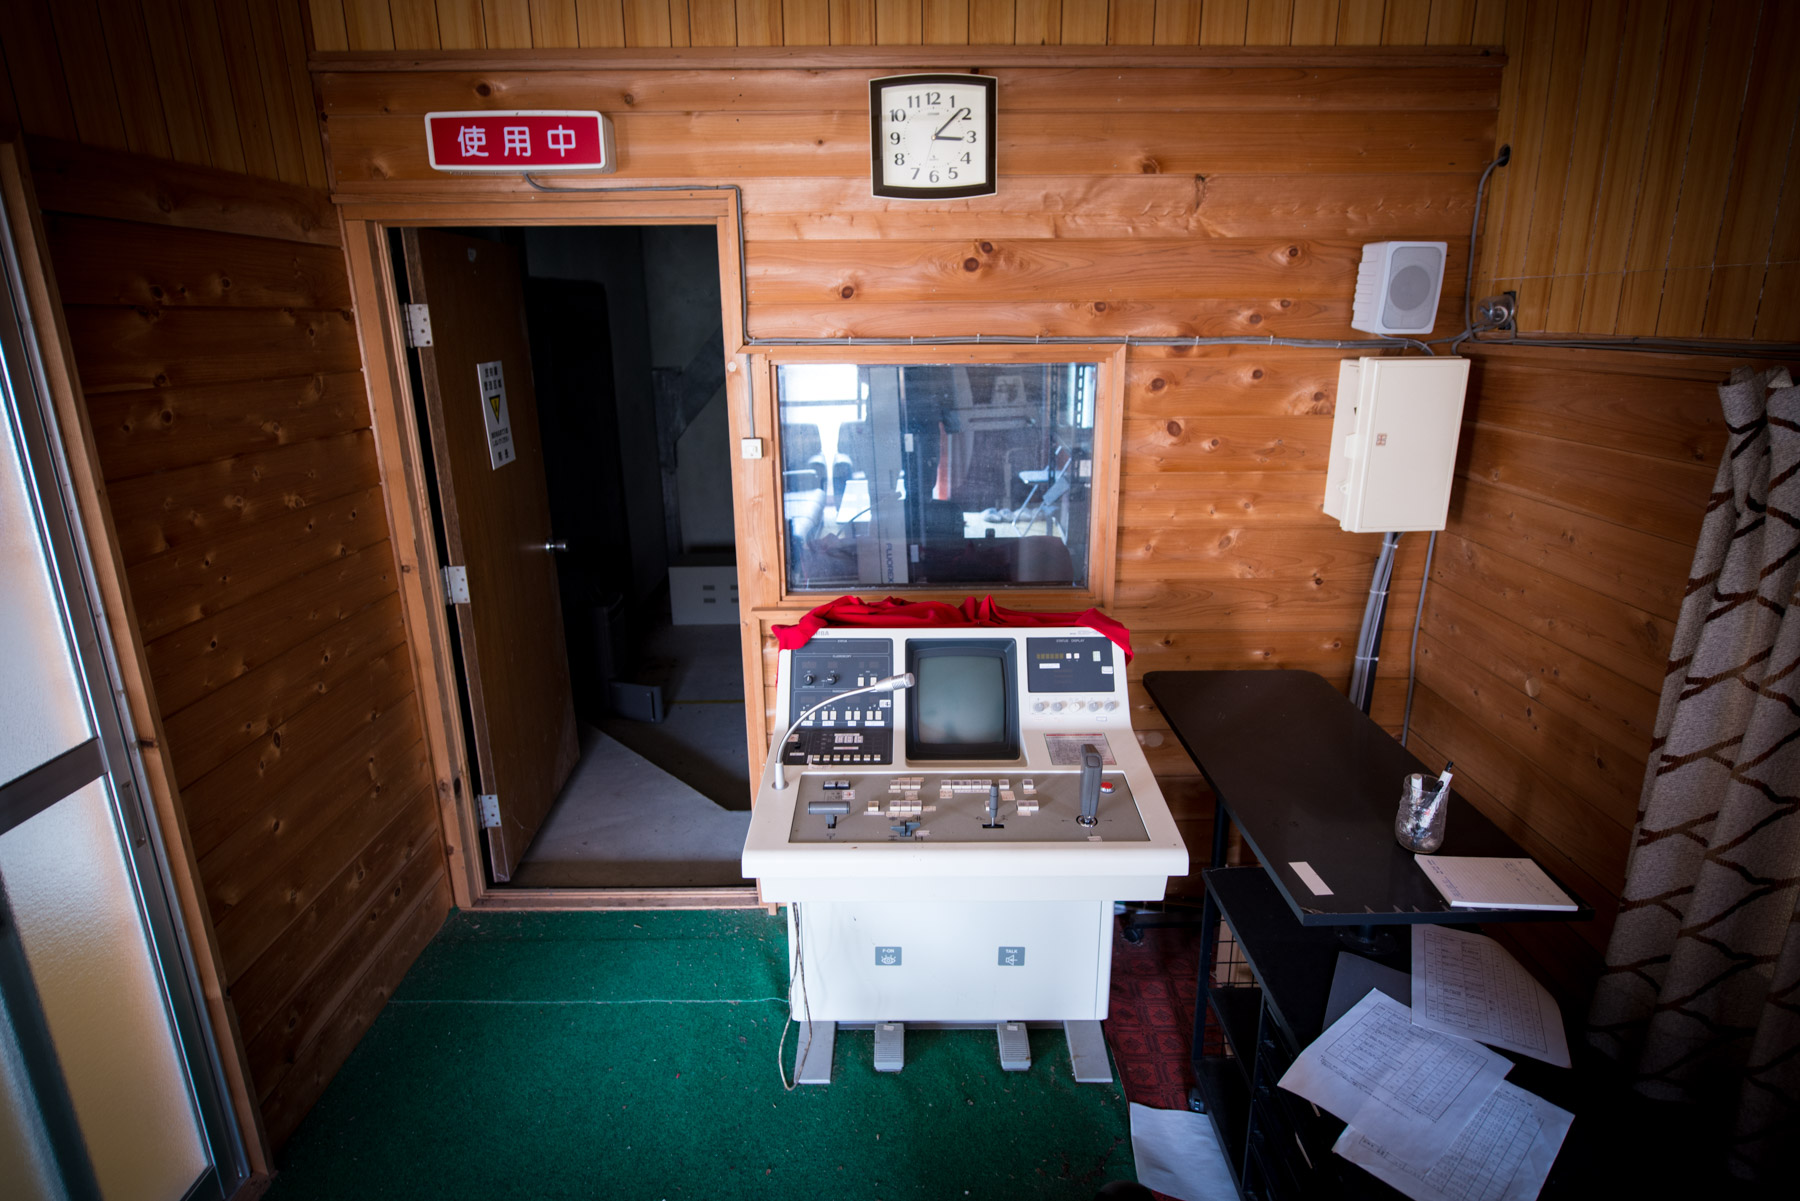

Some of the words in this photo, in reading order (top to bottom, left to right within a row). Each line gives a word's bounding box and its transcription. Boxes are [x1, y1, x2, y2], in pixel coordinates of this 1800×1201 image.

[907, 95, 920, 108] 11
[925, 91, 941, 105] 12
[949, 95, 955, 108] 1
[889, 108, 906, 122] 10
[961, 107, 972, 120] 2
[457, 124, 576, 157] 使用中
[890, 131, 901, 145] 9
[966, 130, 977, 143] 3
[894, 152, 905, 166] 8
[960, 151, 972, 164] 4
[910, 167, 920, 180] 7
[929, 170, 940, 183] 6
[948, 166, 958, 180] 5
